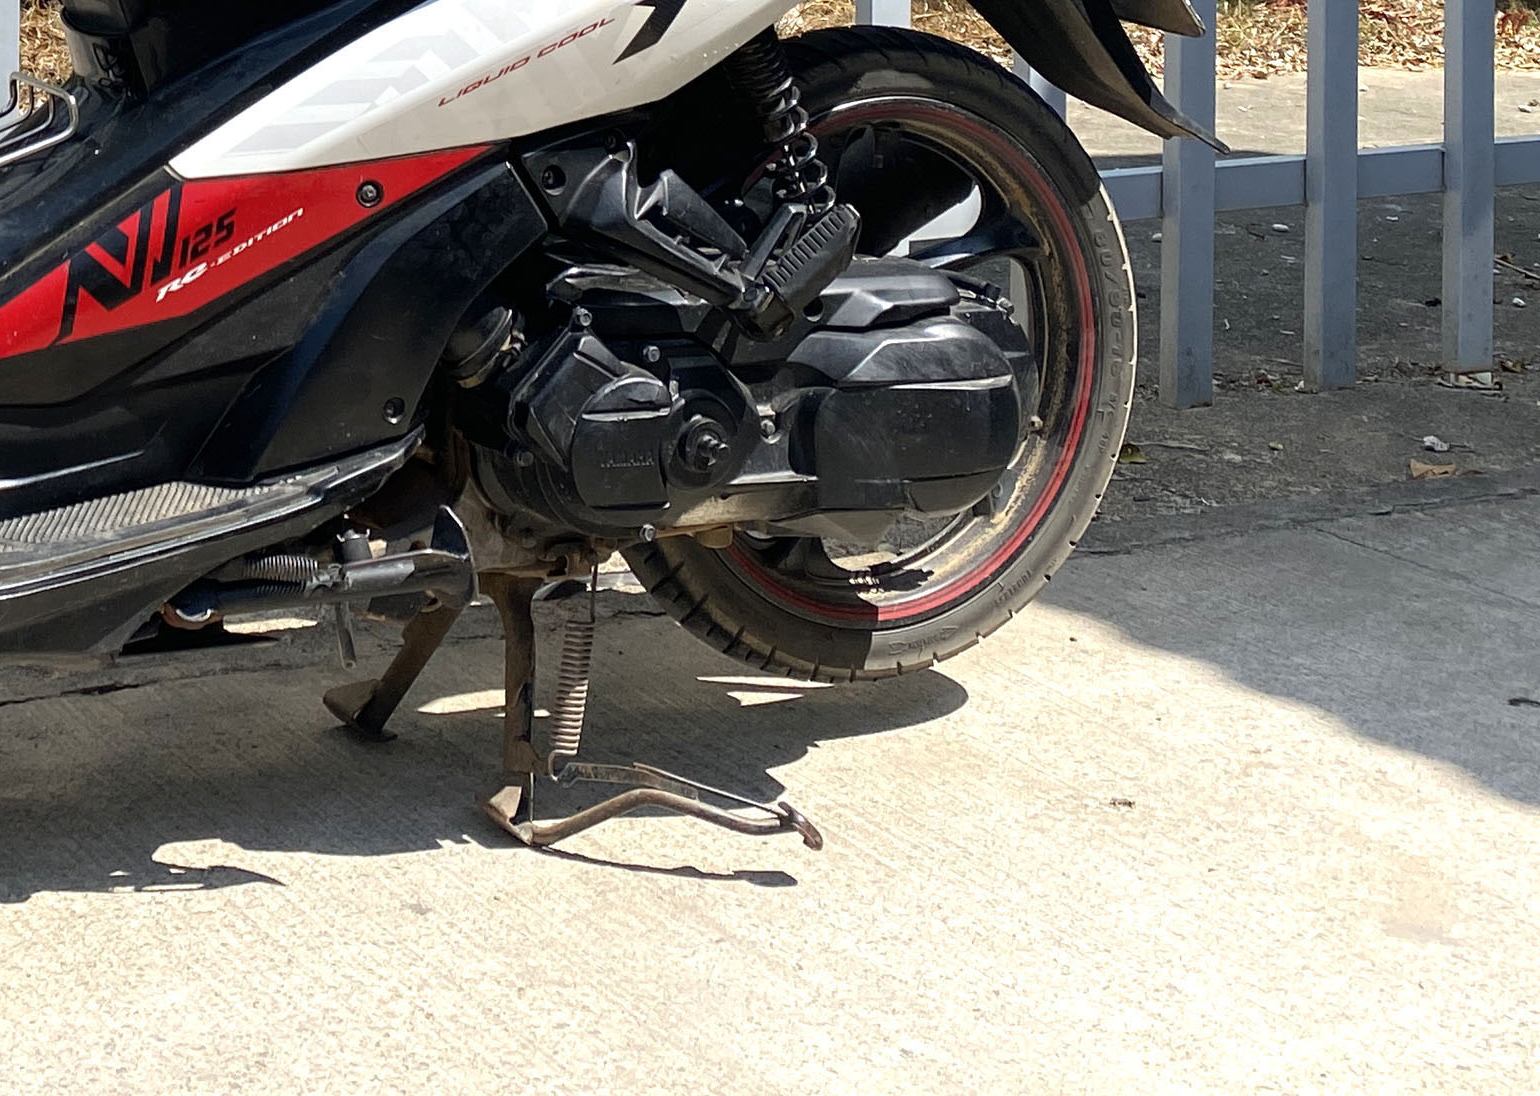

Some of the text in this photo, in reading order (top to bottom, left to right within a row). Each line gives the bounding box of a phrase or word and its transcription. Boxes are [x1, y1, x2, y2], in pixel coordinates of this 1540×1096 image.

[438, 17, 615, 107] LIQUID COOL
[178, 207, 236, 270] 125
